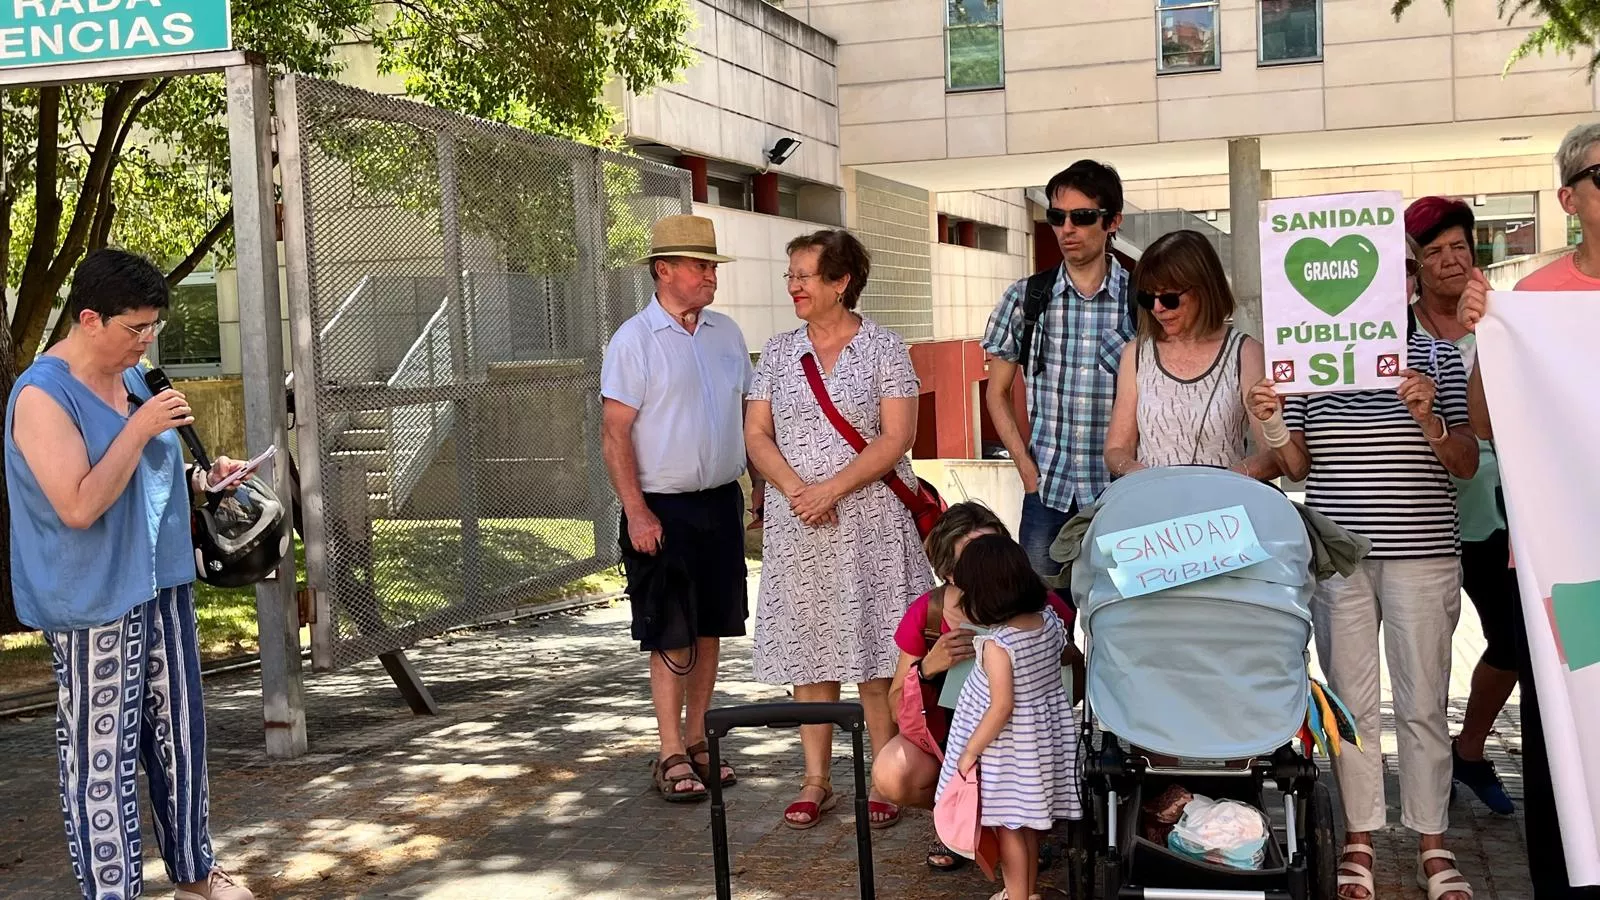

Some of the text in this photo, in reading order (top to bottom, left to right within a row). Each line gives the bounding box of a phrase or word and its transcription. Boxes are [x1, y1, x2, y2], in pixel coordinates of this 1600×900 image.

[14, 0, 162, 19] RA
[0, 12, 195, 59] ENCIAS
[1271, 207, 1395, 233] SANIDAD
[1303, 259, 1359, 281] GRACIAS
[1276, 321, 1397, 345] PÚBLICA
[1308, 343, 1355, 386] SÍ
